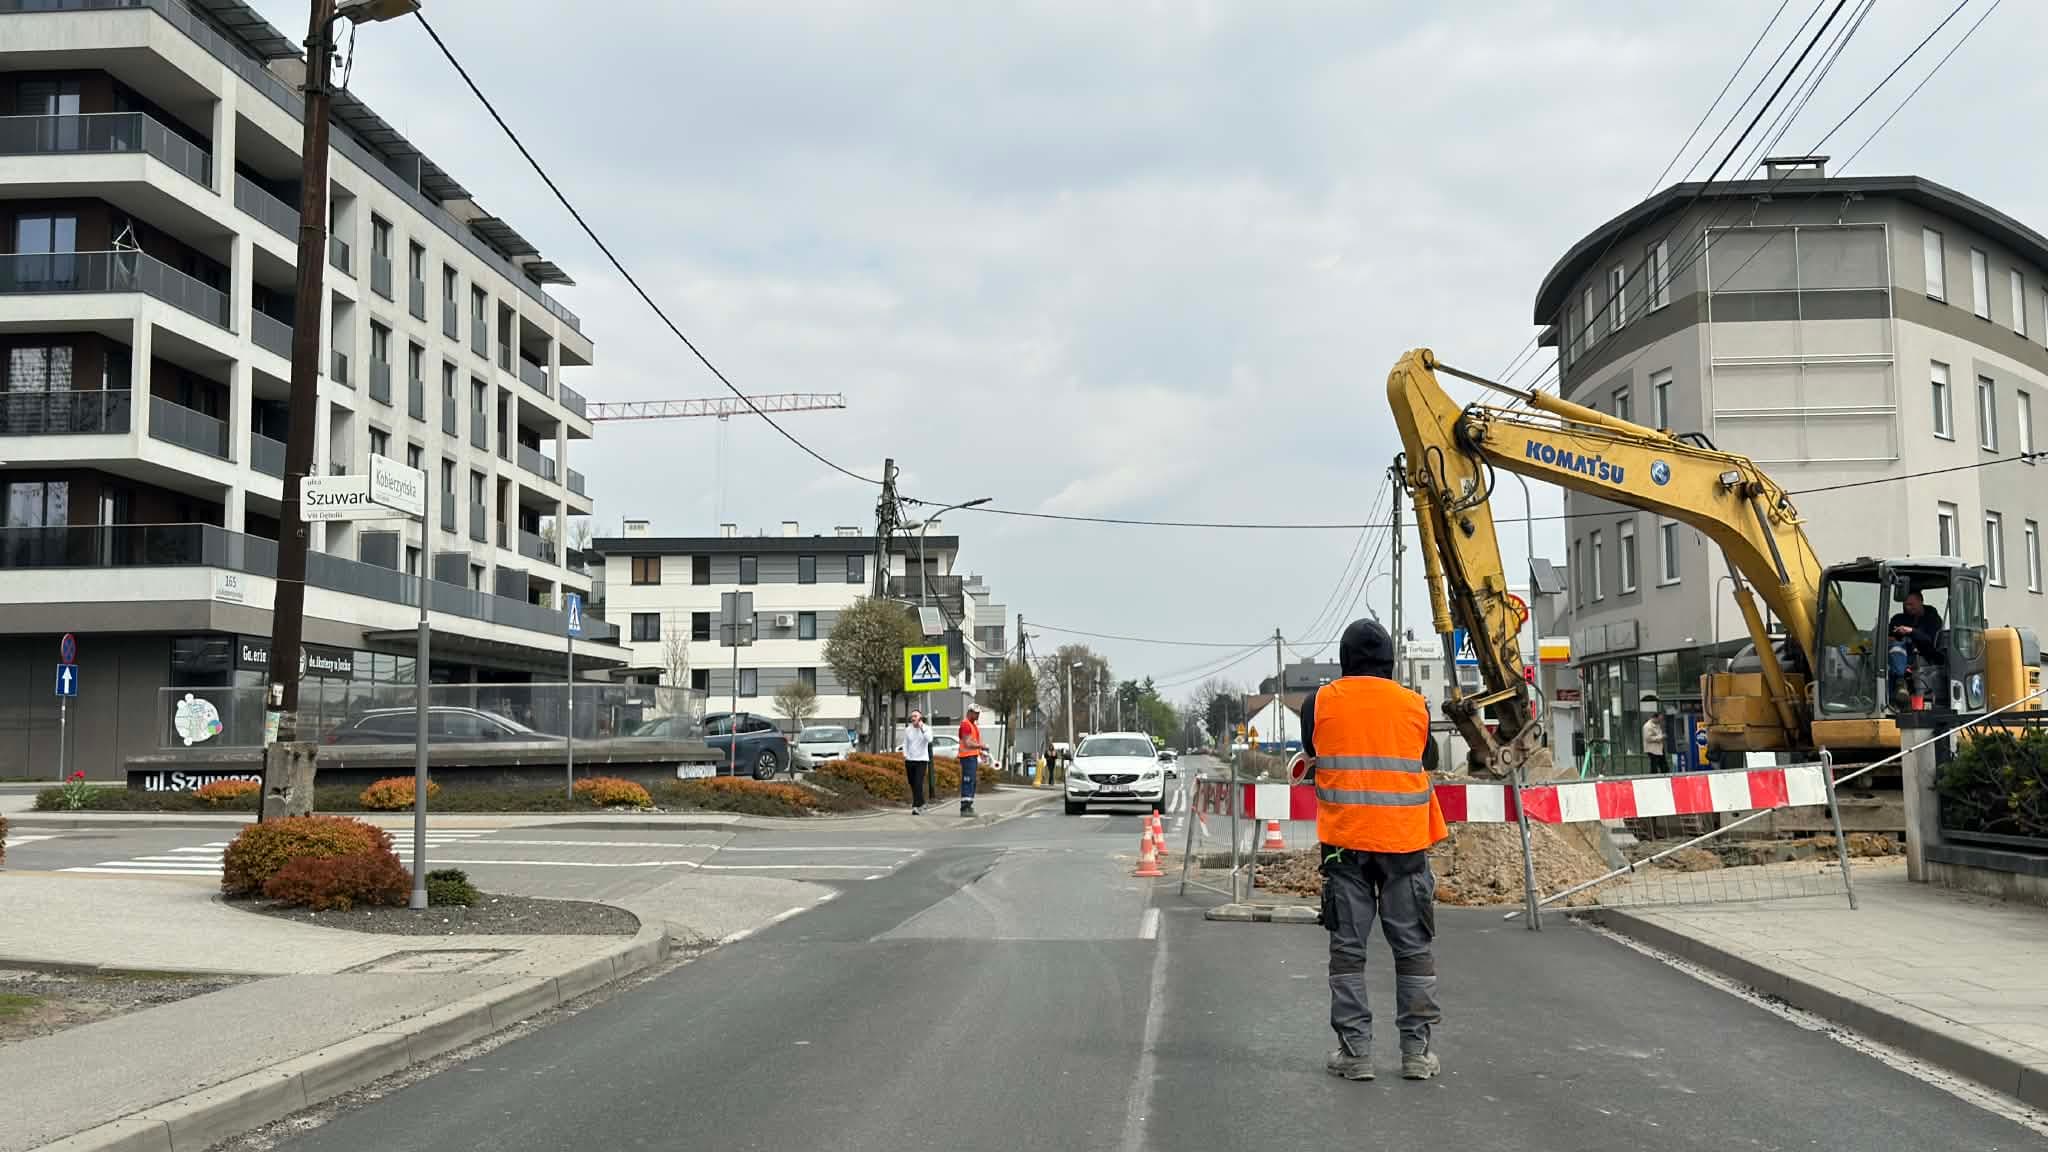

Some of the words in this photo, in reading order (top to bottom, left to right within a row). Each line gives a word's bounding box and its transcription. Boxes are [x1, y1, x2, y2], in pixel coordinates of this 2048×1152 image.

[1525, 439, 1625, 484] KOMATSU
[376, 468, 417, 498] Kobierzyńska
[225, 575, 237, 588] 165
[243, 644, 267, 663] Gaeria
